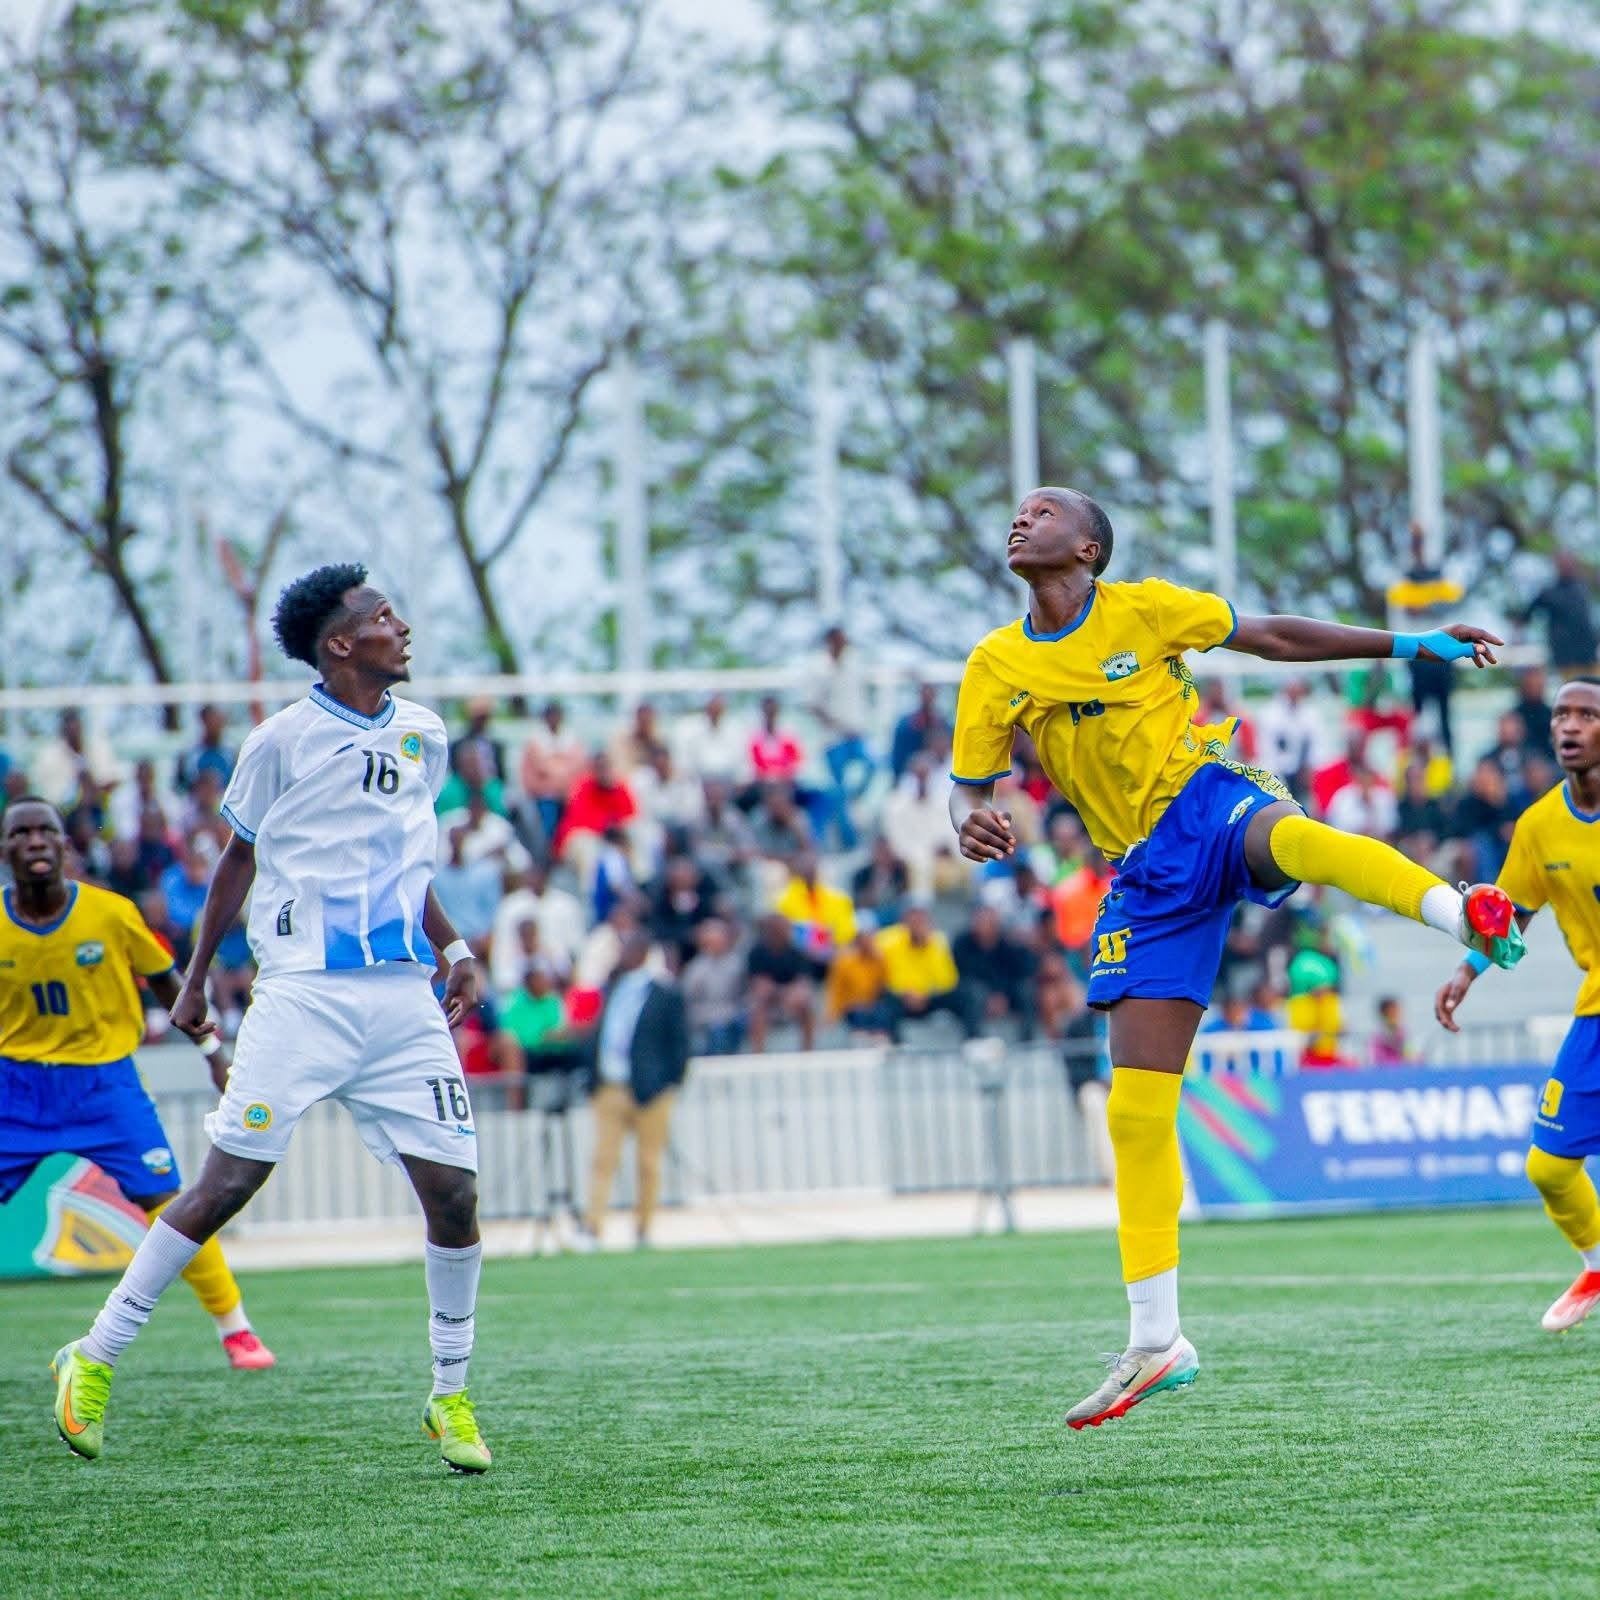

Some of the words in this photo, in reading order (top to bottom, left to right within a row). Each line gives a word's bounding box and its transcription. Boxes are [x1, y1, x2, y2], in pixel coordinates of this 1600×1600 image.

[360, 750, 399, 794] 16
[31, 981, 70, 1016] 10
[425, 1078, 469, 1121] 16
[1303, 1085, 1534, 1143] FERWAF
[1541, 1078, 1565, 1118] 9
